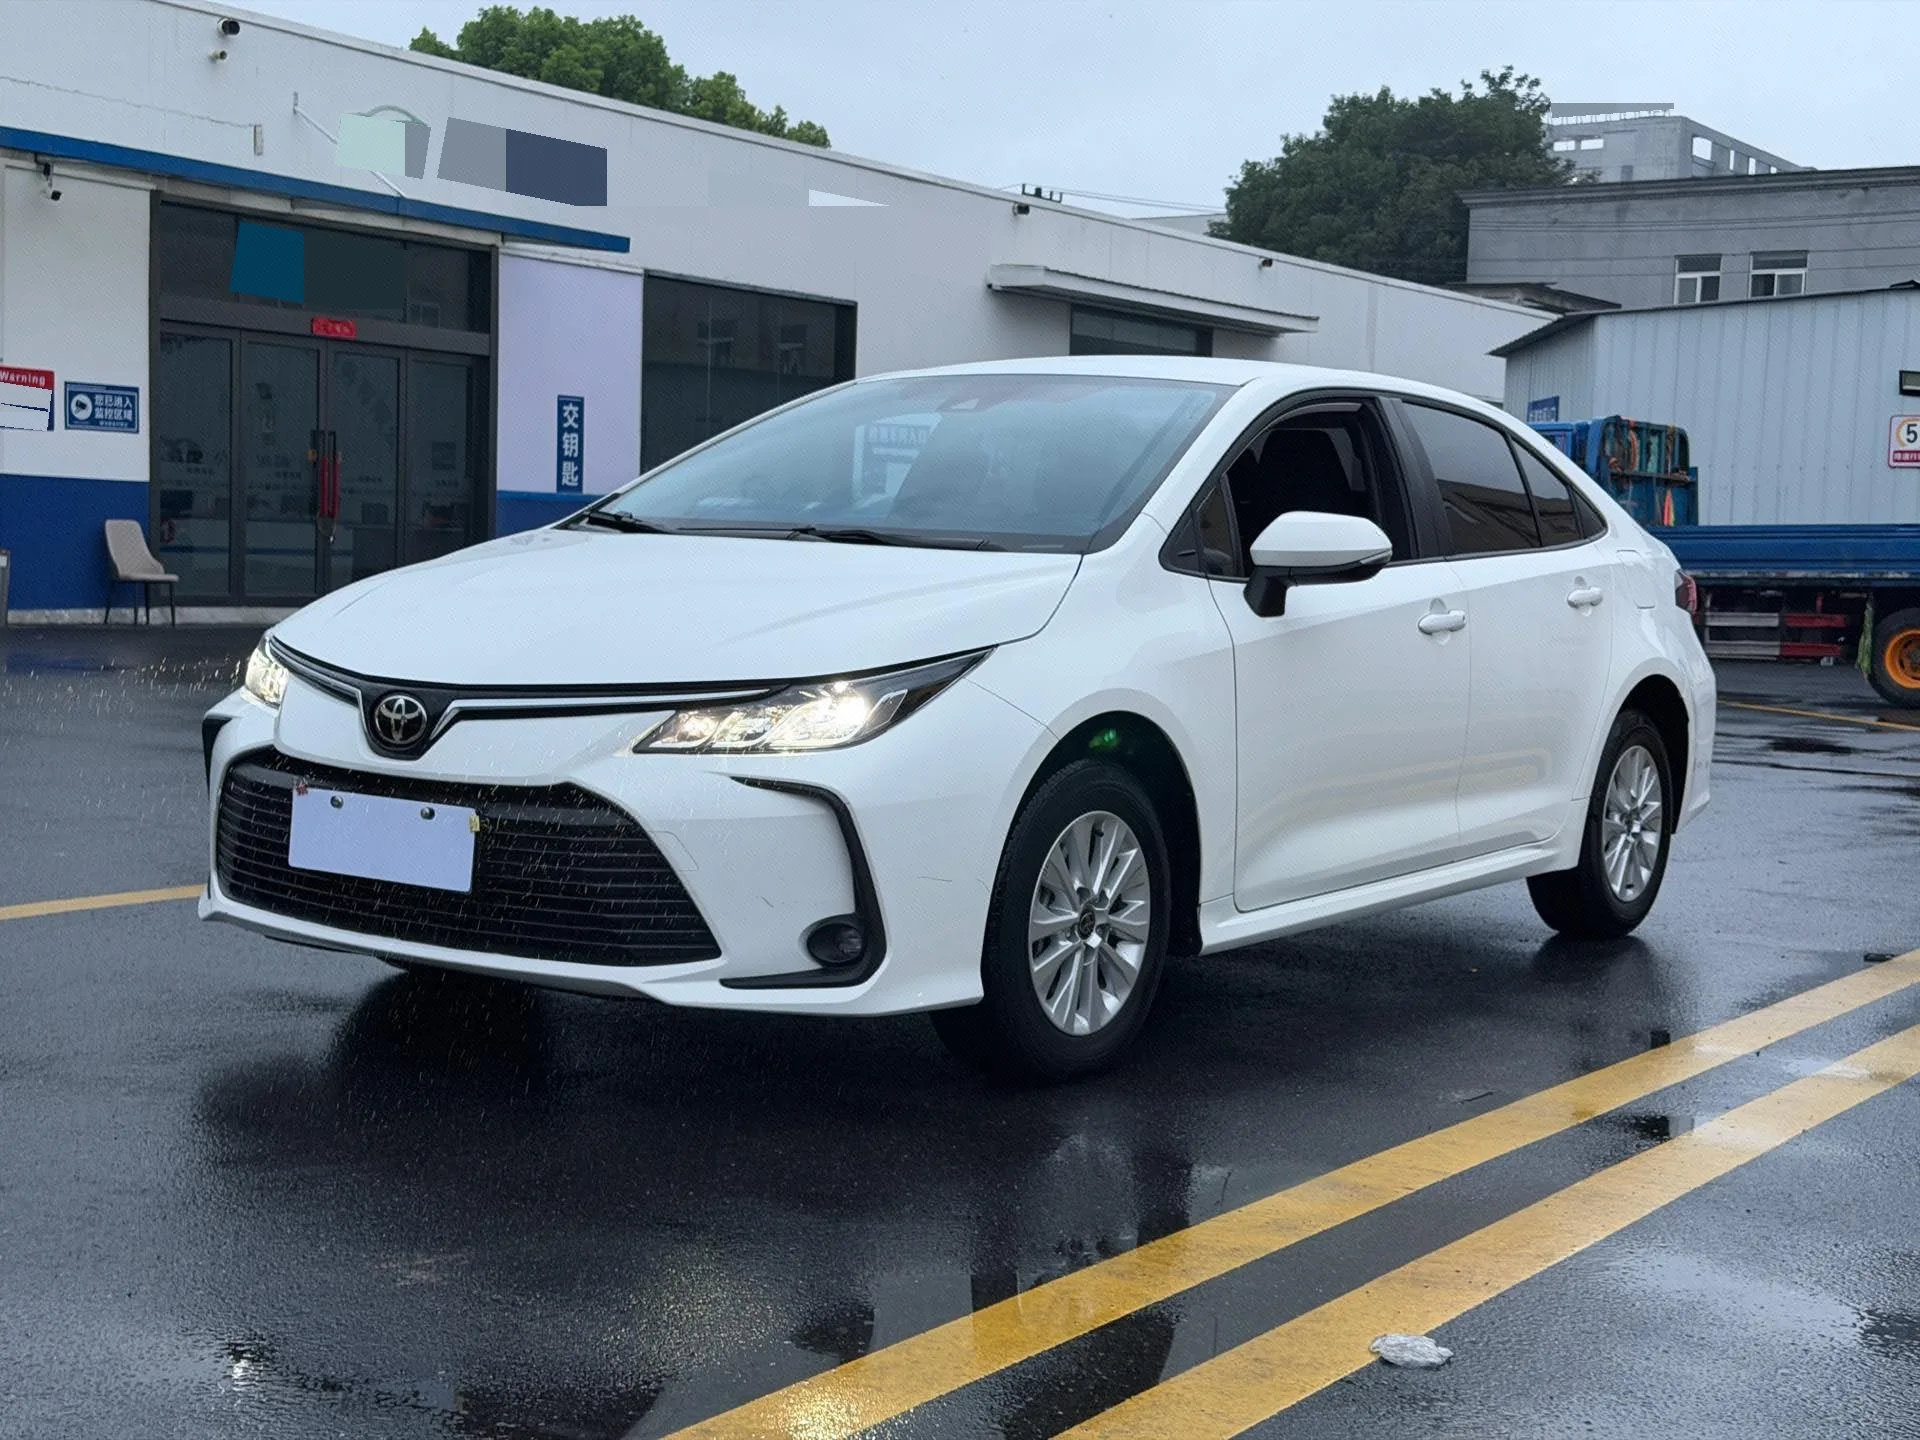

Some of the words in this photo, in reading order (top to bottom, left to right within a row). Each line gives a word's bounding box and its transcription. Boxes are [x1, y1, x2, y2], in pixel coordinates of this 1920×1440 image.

[0, 370, 46, 387] Warning
[1906, 423, 1918, 443] 5
[562, 402, 579, 486] 交钥匙
